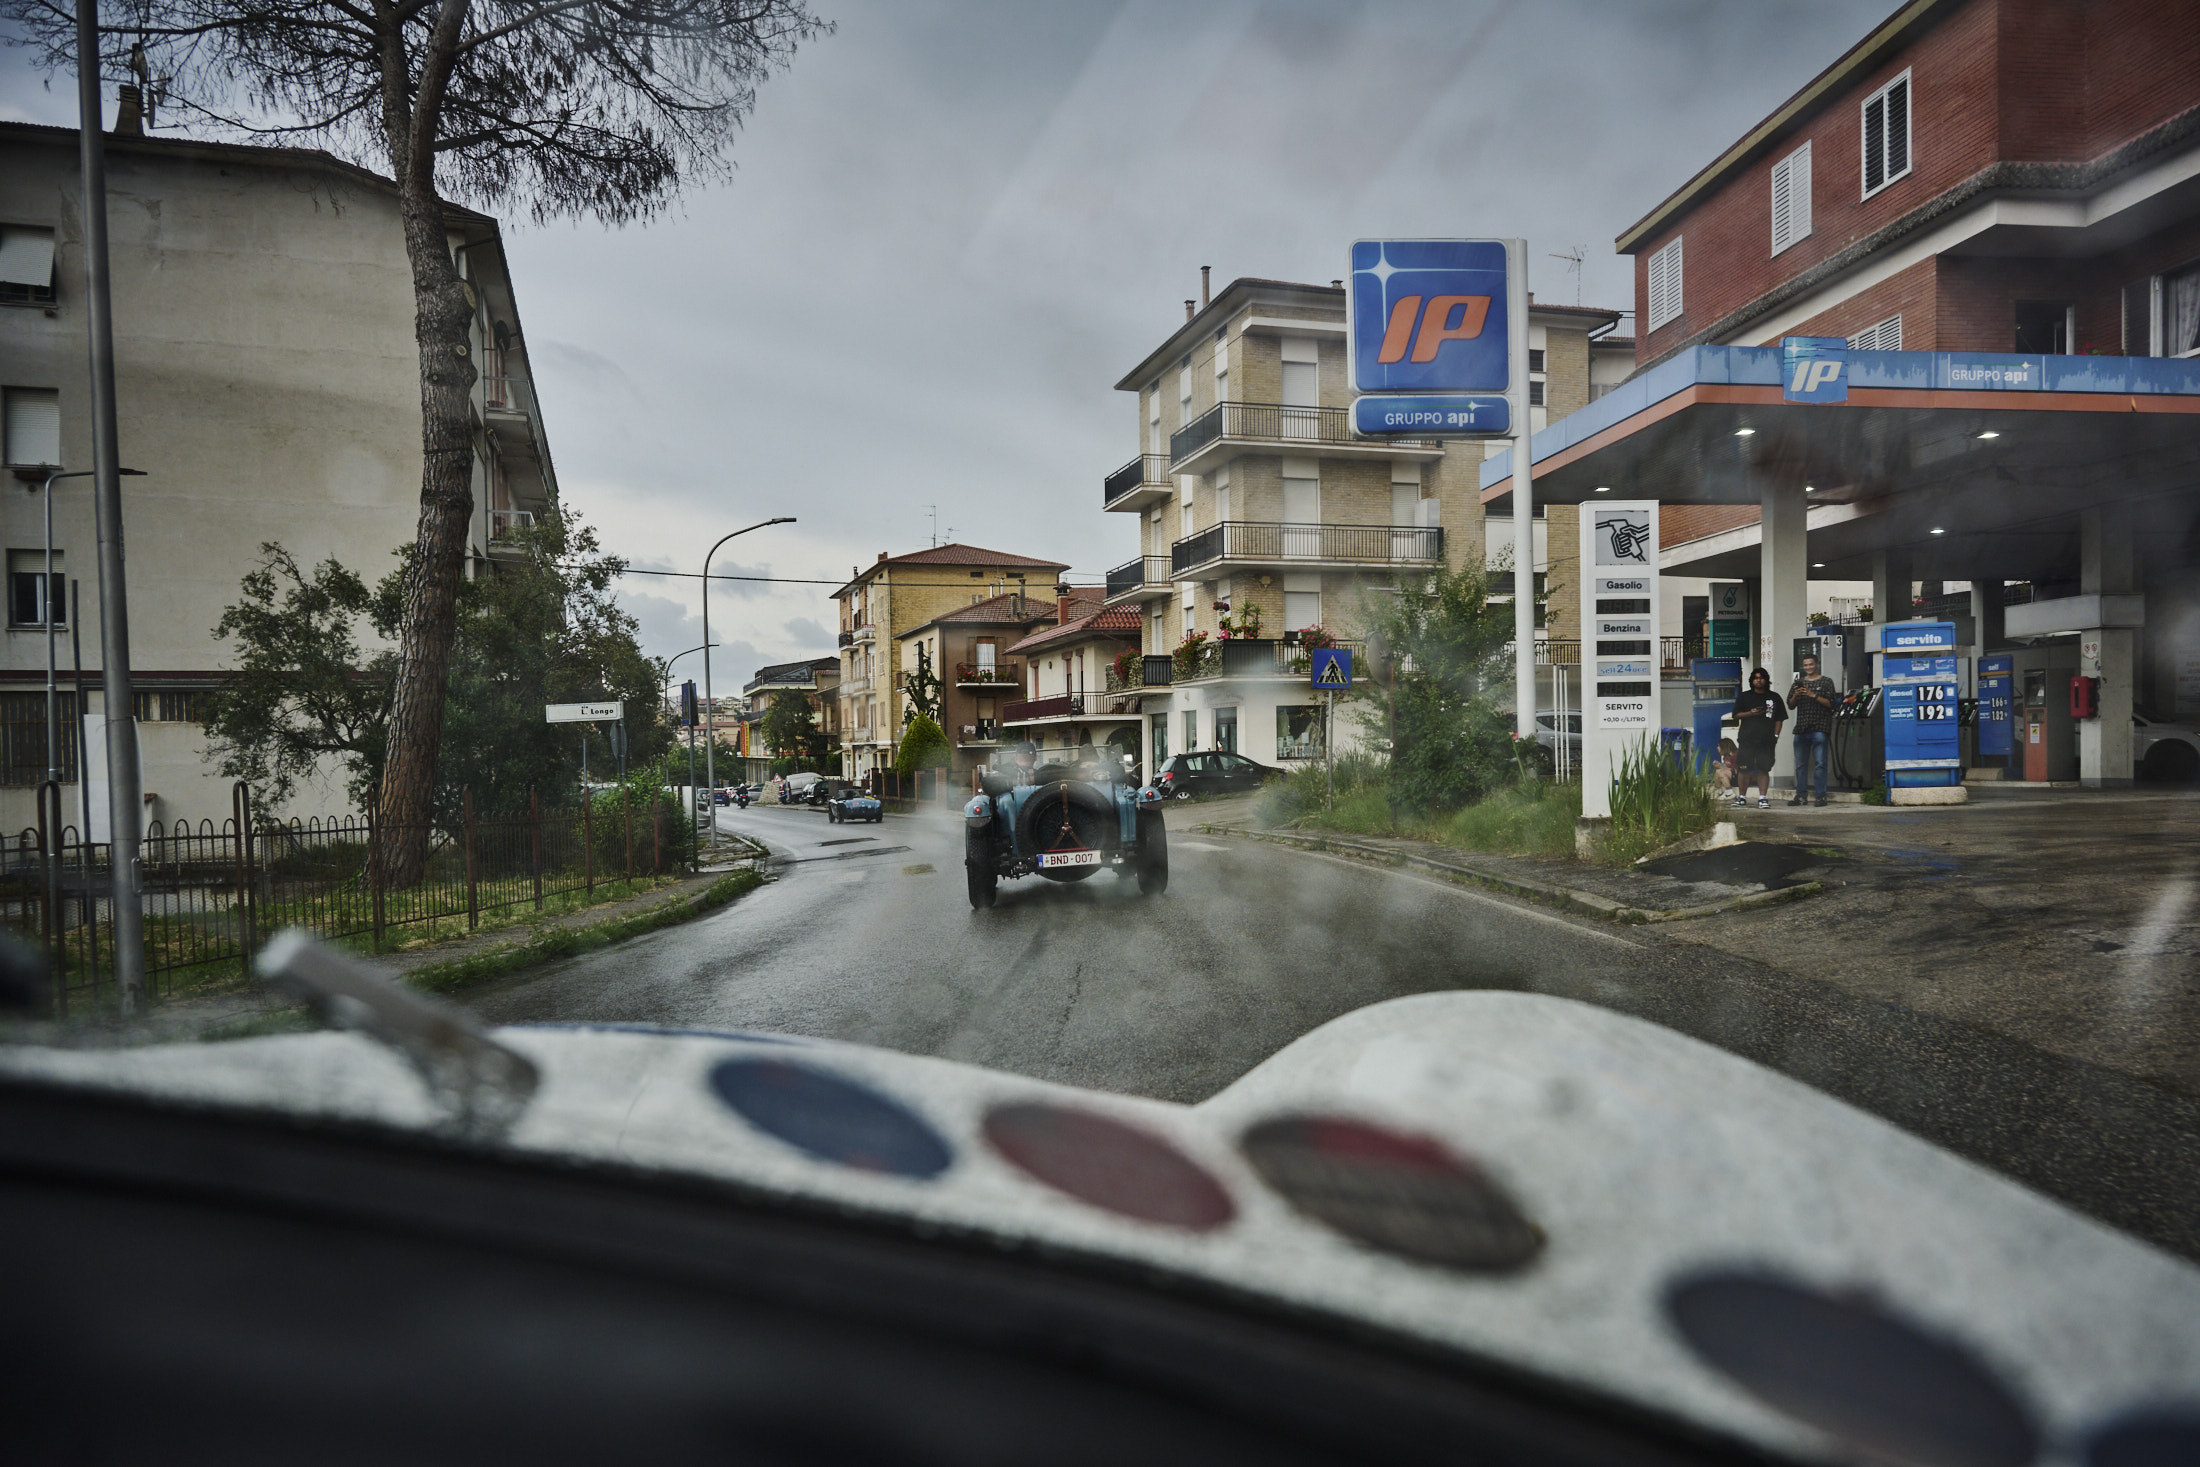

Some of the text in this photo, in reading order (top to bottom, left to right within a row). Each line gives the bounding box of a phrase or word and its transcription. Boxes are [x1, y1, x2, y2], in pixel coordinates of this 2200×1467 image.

[1377, 295, 1492, 364] IP
[1790, 361, 1843, 393] IP
[1951, 369, 2028, 384] GRUPPO api
[1385, 412, 1475, 427] GRUPPO api
[1606, 581, 1642, 589] Gasolio
[1603, 624, 1641, 632] Benzina
[1823, 636, 1842, 646] 4 3
[1897, 634, 1942, 645] servito
[1617, 664, 1631, 673] 24
[1918, 685, 1944, 700] 176
[1918, 705, 1945, 720] 192
